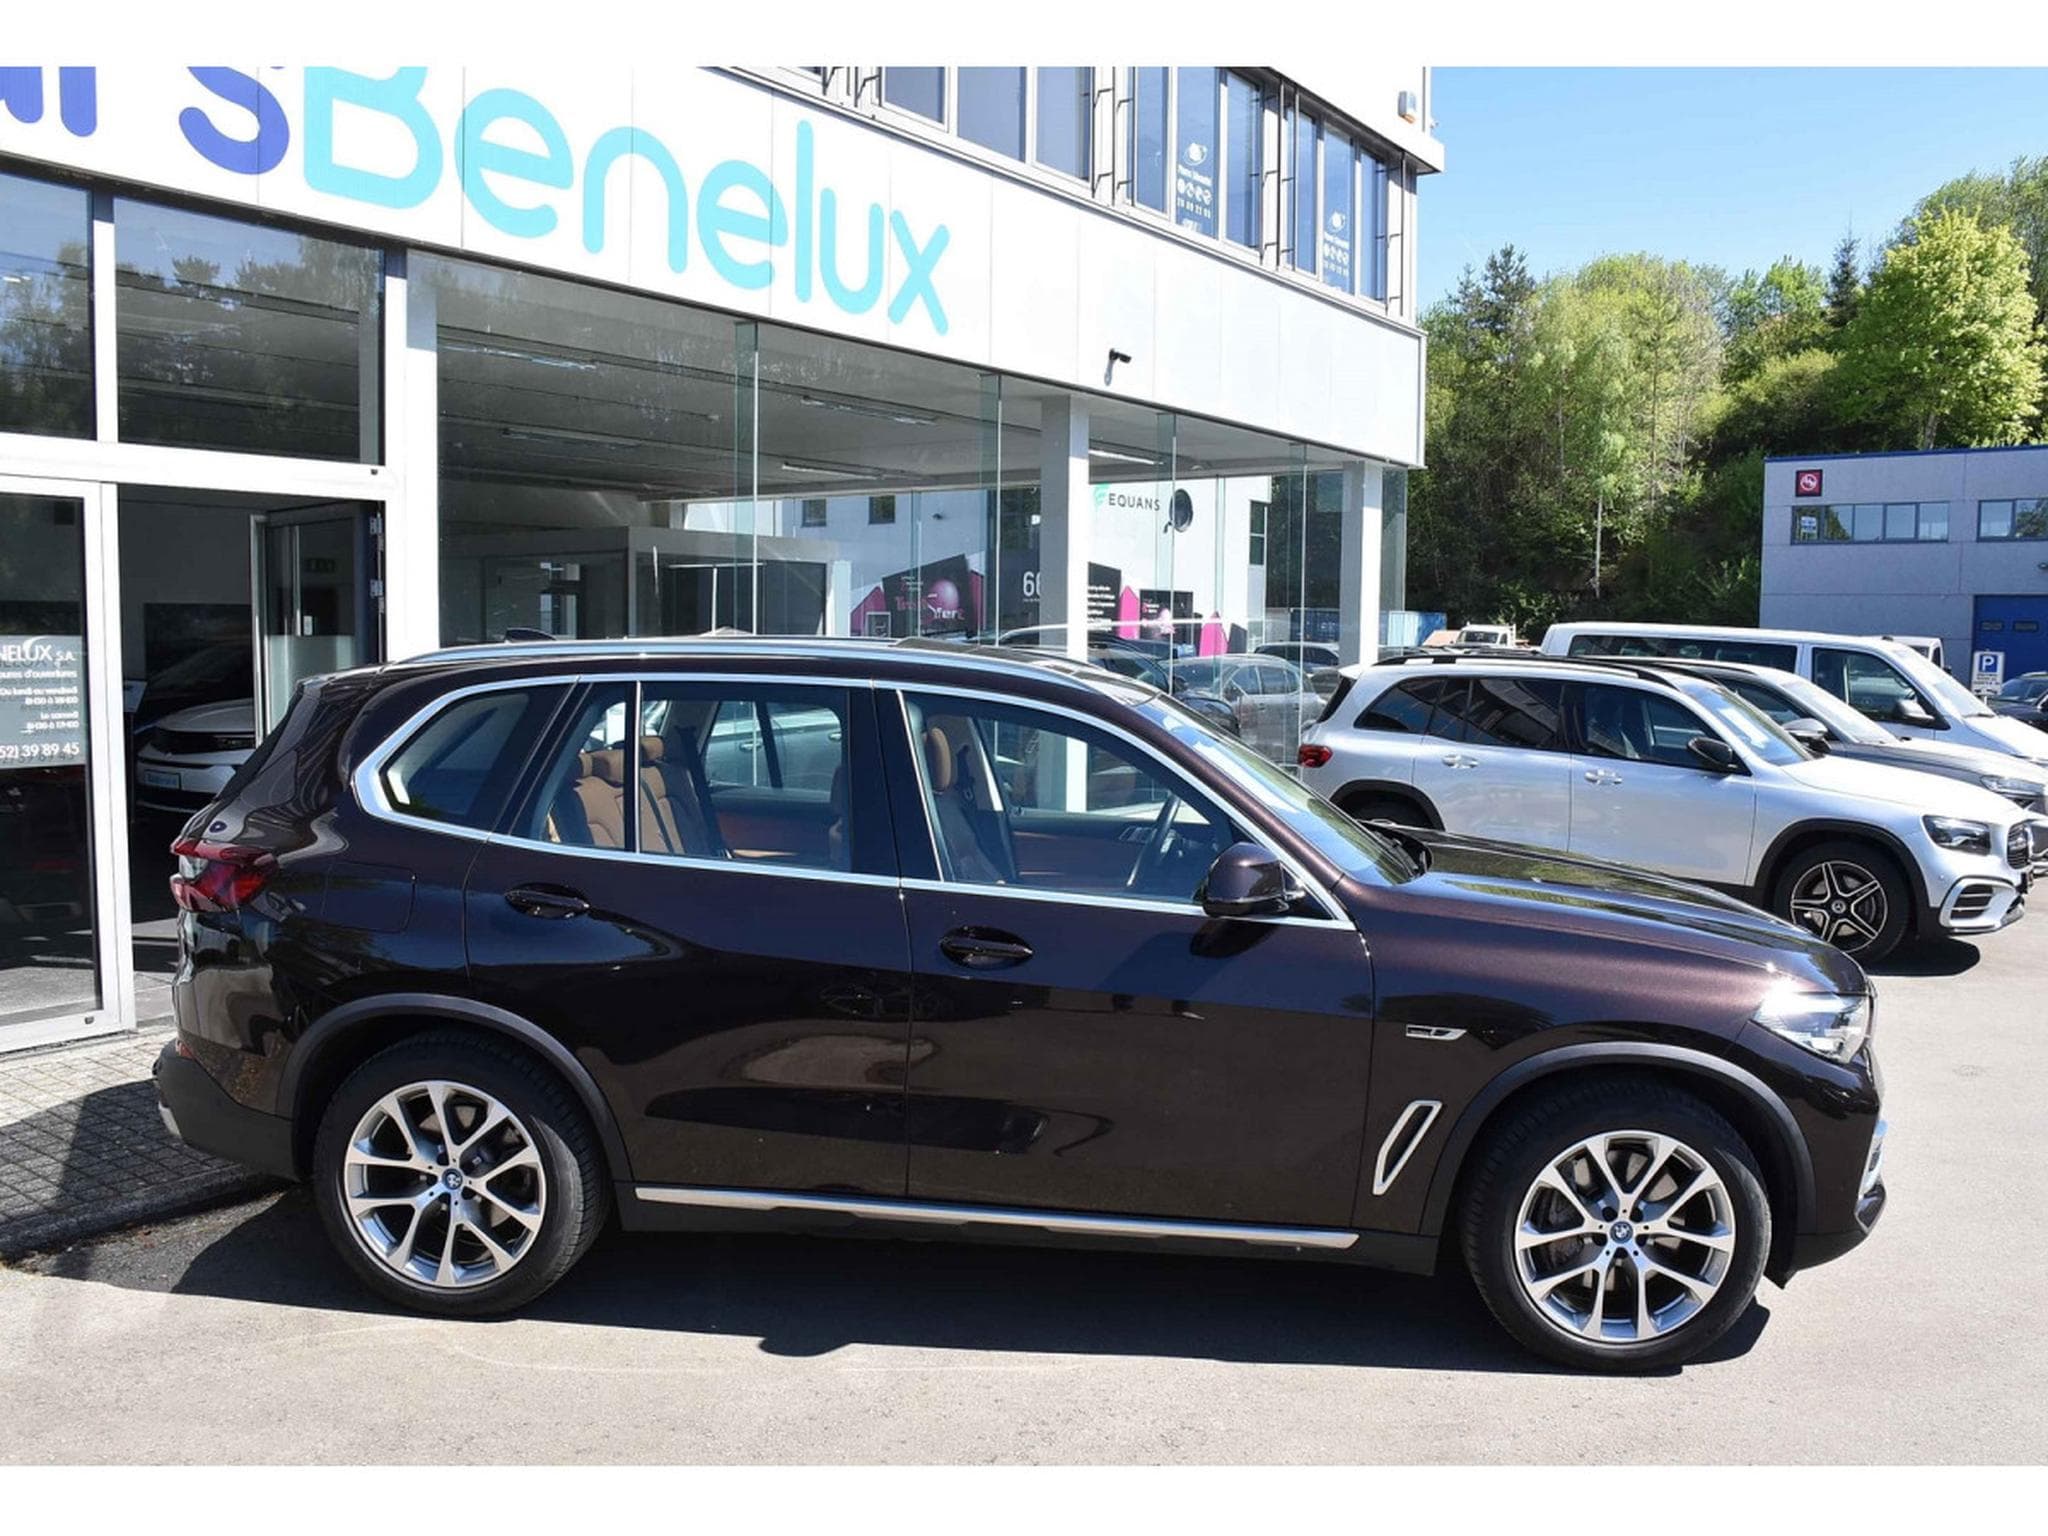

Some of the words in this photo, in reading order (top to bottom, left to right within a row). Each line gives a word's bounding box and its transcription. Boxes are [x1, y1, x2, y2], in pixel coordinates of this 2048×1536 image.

[1108, 493, 1160, 512] EQUANS
[21, 745, 39, 757] 39
[42, 743, 60, 756] 89
[62, 742, 80, 755] 45
